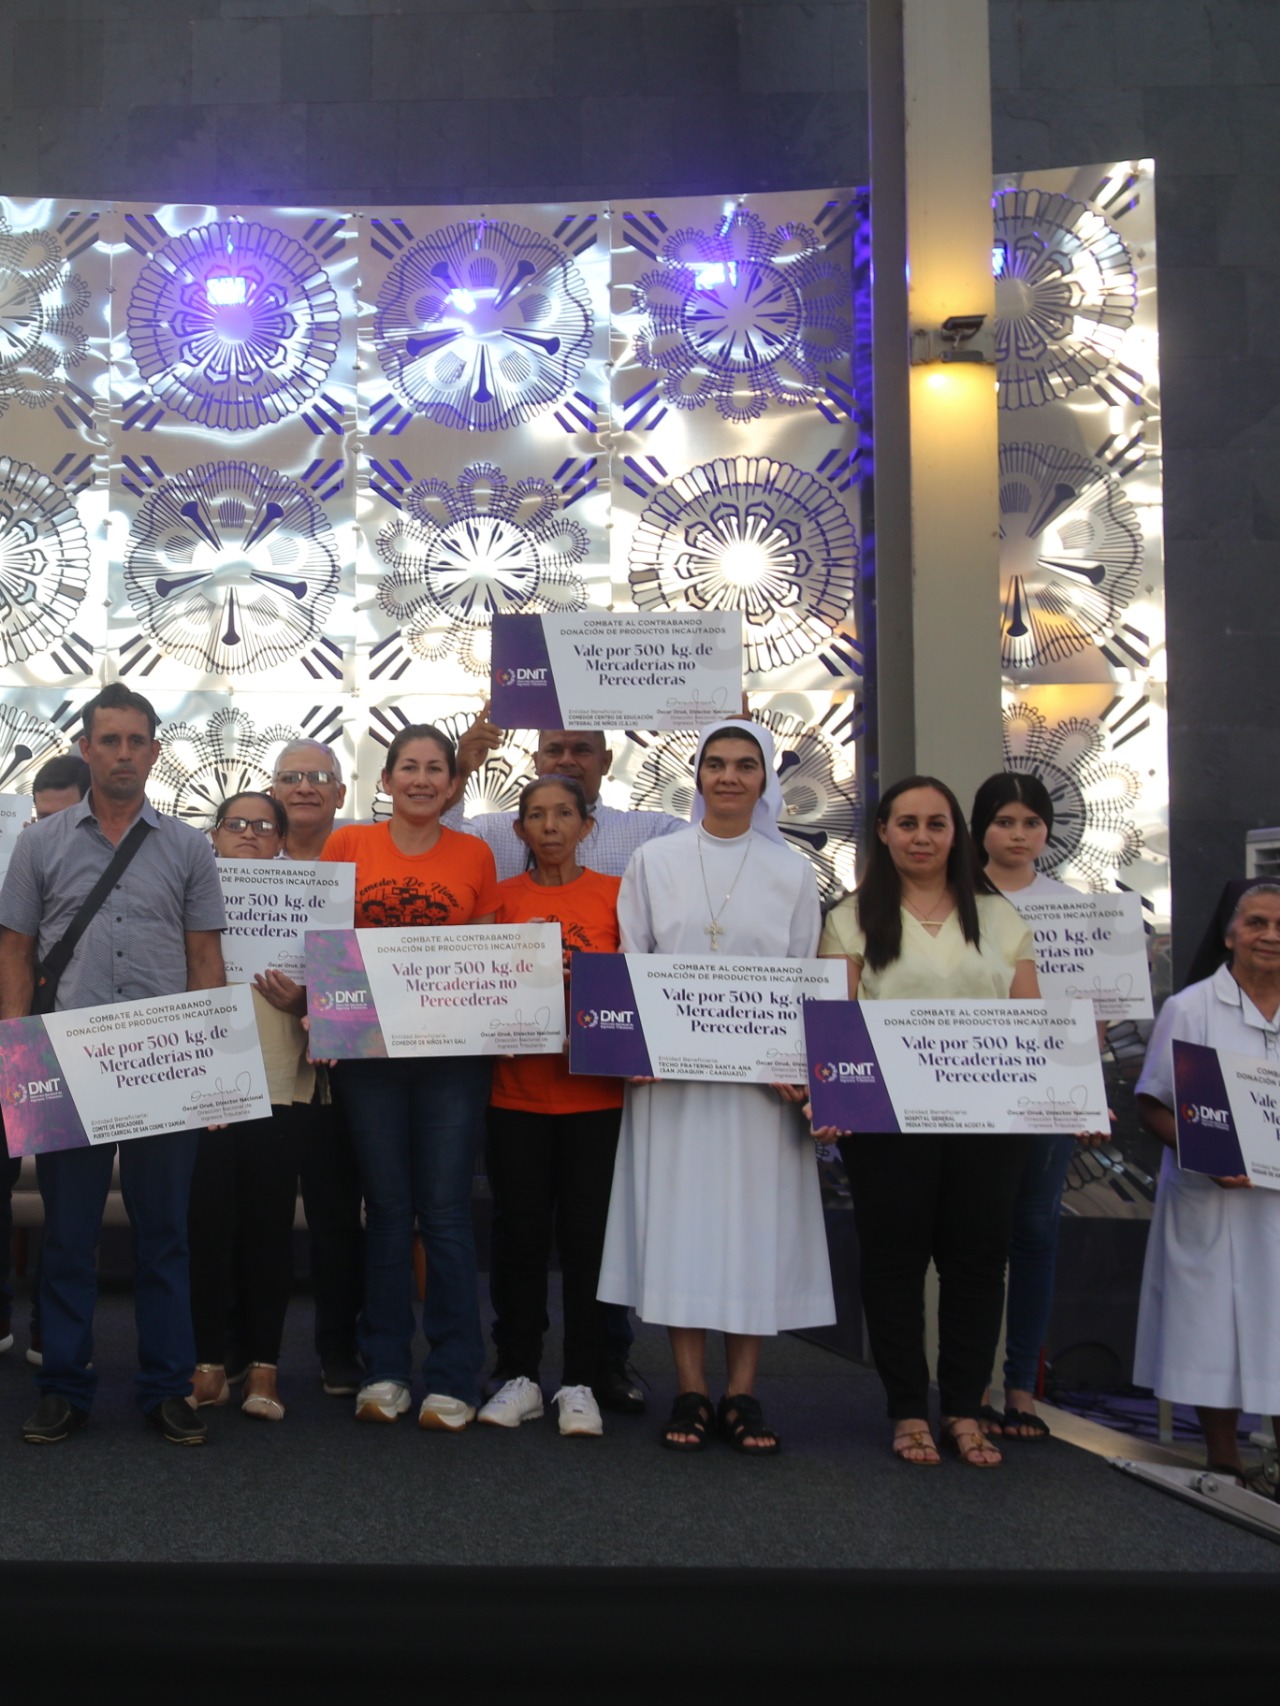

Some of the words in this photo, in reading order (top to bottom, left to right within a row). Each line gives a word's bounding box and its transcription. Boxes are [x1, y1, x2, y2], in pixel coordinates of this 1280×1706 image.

[573, 644, 603, 657] Vale
[606, 647, 631, 660] por
[635, 644, 665, 656] 500
[671, 643, 692, 659] kg.
[695, 643, 713, 656] de
[586, 657, 675, 671] Mercaderías
[678, 661, 696, 670] no
[517, 668, 547, 681] DNIT
[599, 673, 686, 686] Perecederas
[359, 877, 397, 896] omedor
[248, 893, 278, 907] 500
[285, 894, 305, 911] kg.
[308, 895, 326, 909] de
[392, 962, 423, 976] Vale
[426, 965, 451, 979] por
[454, 961, 485, 974] 500
[491, 960, 513, 977] kg.
[515, 959, 534, 973] de
[406, 977, 496, 992] Mercaderías
[499, 979, 517, 989] no
[335, 990, 366, 1003] DNIT
[420, 992, 508, 1007] Perecederas
[662, 988, 695, 1001] Vale
[698, 993, 725, 1006] por
[729, 990, 763, 1004] 500
[770, 991, 793, 1008] kg.
[600, 1010, 633, 1023] DNIT
[677, 1003, 774, 1019] Mercaderías
[778, 1011, 797, 1020] no
[691, 1020, 787, 1035] Perecederas
[83, 1042, 115, 1058] Vale
[118, 1041, 144, 1058] por
[147, 1032, 179, 1049] 500
[185, 1030, 207, 1046] kg.
[210, 1025, 228, 1040] de
[901, 1036, 936, 1050] Vale
[940, 1040, 968, 1053] por
[972, 1036, 1008, 1049] 500
[1015, 1036, 1040, 1053] kg.
[1044, 1036, 1064, 1050] de
[99, 1050, 193, 1074] Mercaderías
[195, 1047, 214, 1059] no
[918, 1051, 1022, 1066] Mercaderías
[1025, 1056, 1046, 1066] no
[116, 1065, 207, 1088] Perecederas
[838, 1062, 873, 1076] DNIT
[935, 1069, 1037, 1083] Perecederas
[28, 1077, 60, 1094] DNIT
[1250, 1091, 1277, 1107] Vale
[1200, 1105, 1228, 1122] DNIT
